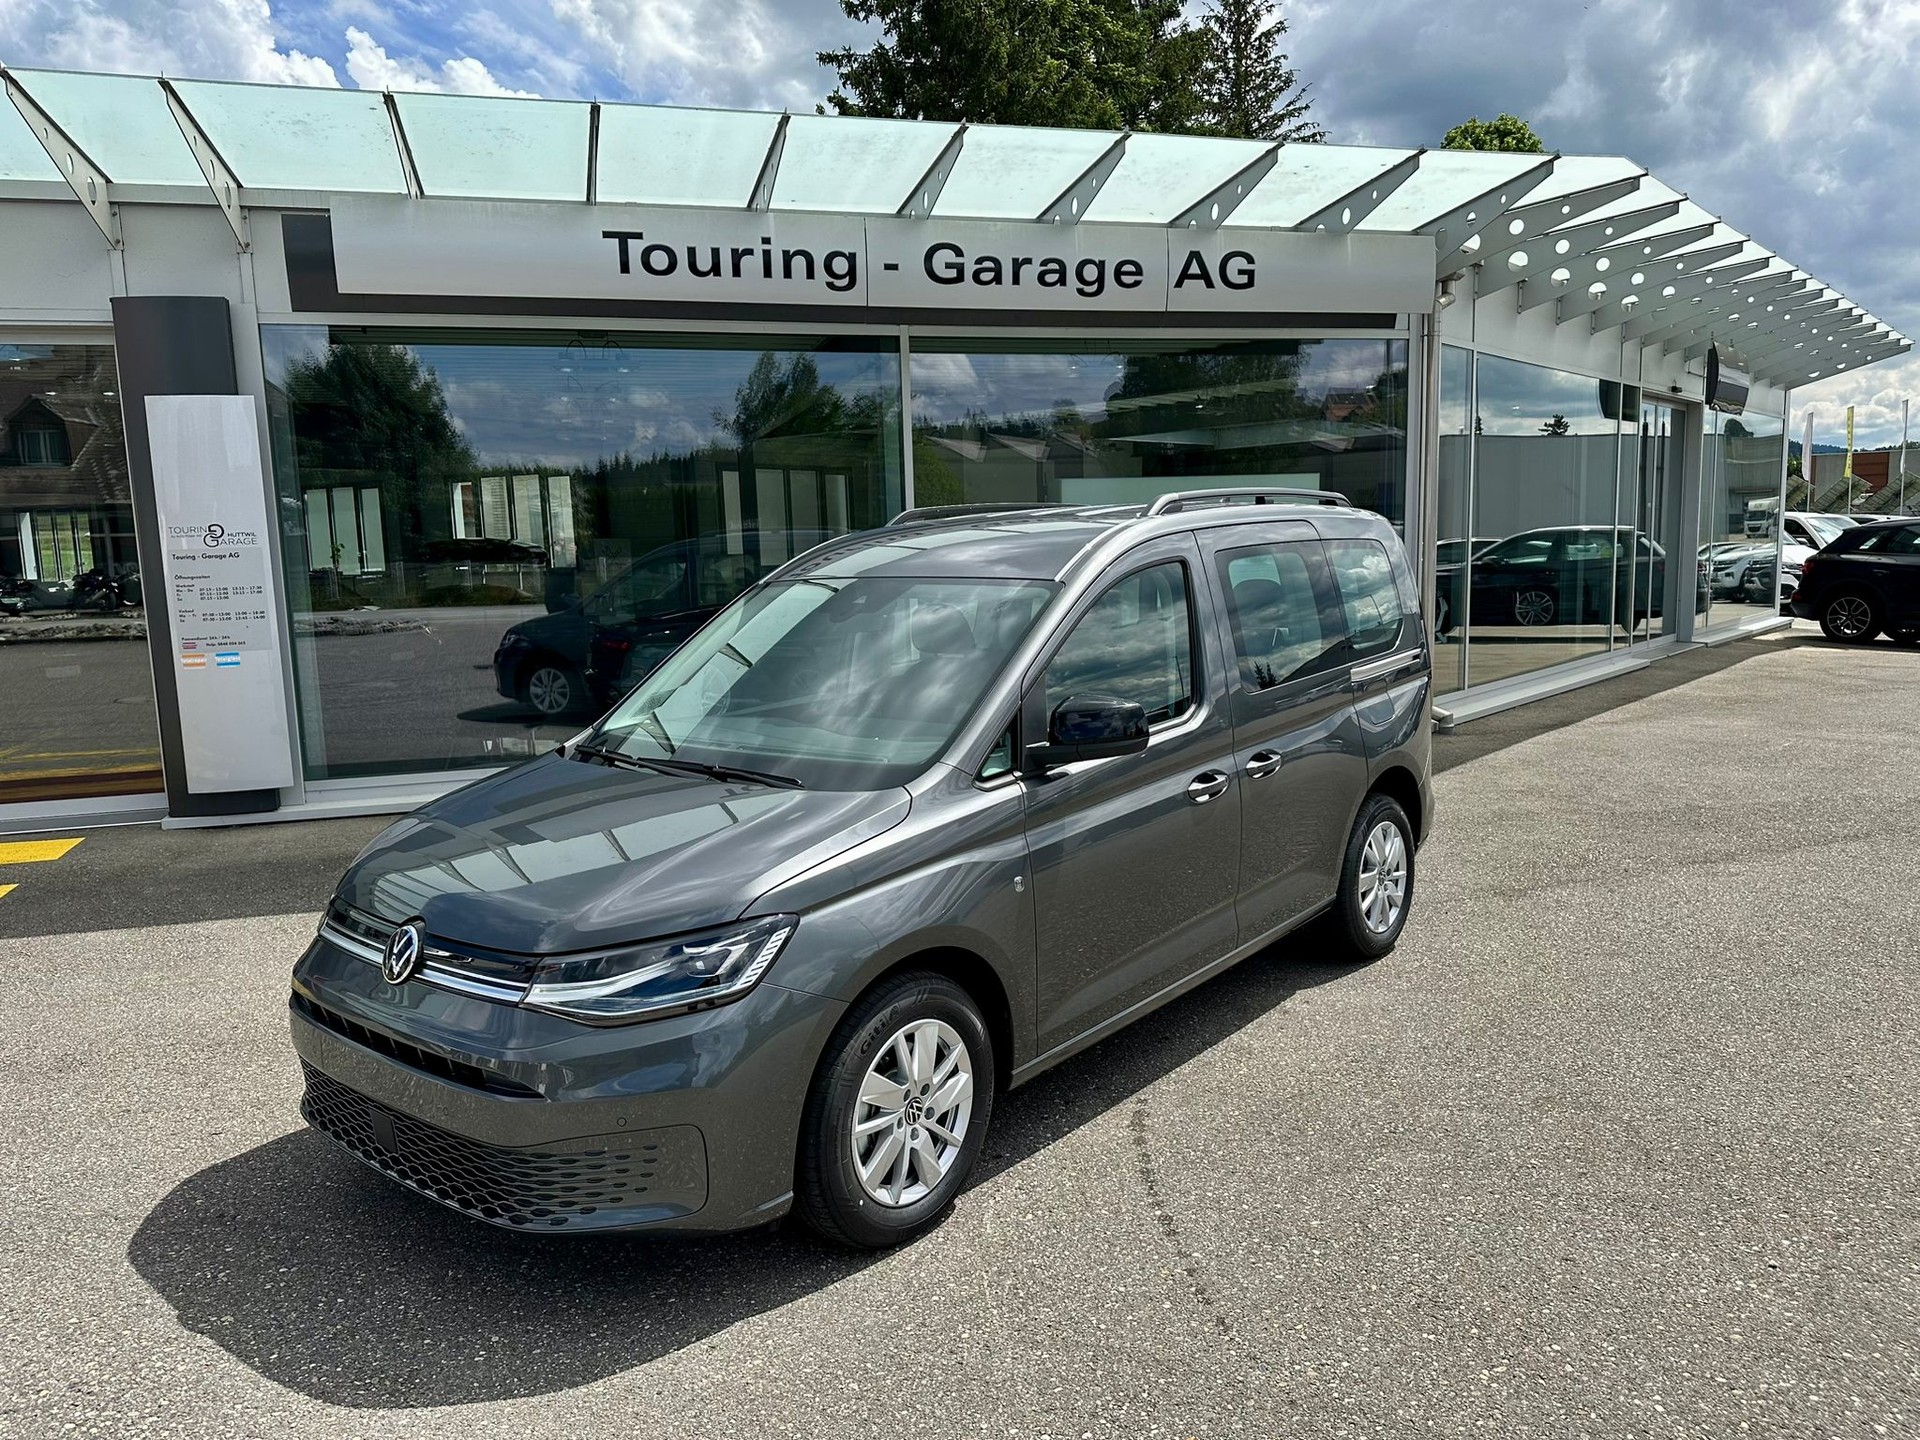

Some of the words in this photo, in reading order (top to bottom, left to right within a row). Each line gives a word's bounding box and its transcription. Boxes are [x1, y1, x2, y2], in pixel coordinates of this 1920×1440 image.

[602, 230, 858, 292] Touring
[883, 262, 899, 271] -
[923, 241, 1144, 298] Garage
[1173, 249, 1256, 290] AG
[172, 553, 196, 561] Touring
[201, 552, 227, 560] Garage
